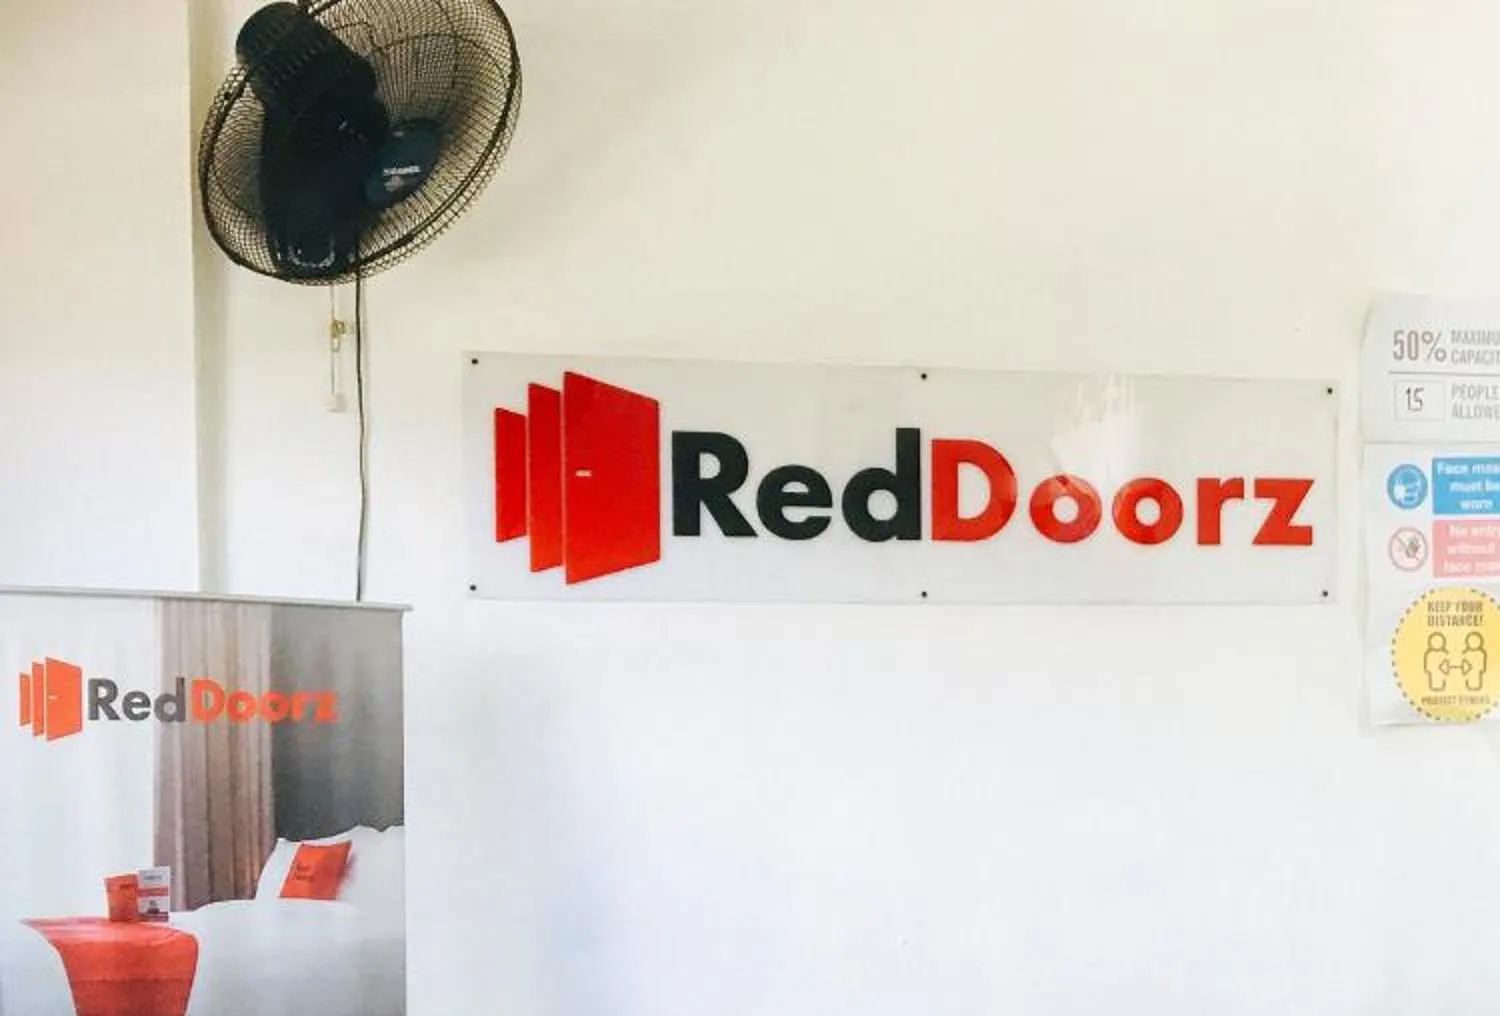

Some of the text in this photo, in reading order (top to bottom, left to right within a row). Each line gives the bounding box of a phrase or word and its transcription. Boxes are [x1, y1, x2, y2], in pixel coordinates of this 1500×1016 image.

[1392, 329, 1448, 363] 50%
[1405, 386, 1425, 412] 15
[1451, 384, 1500, 401] PEOPLE
[1436, 462, 1469, 475] Face
[671, 427, 1315, 547] RedDoorz
[1448, 480, 1482, 493] must
[1427, 600, 1483, 613] KEEP YOUR
[87, 676, 340, 724] RedDoorz
